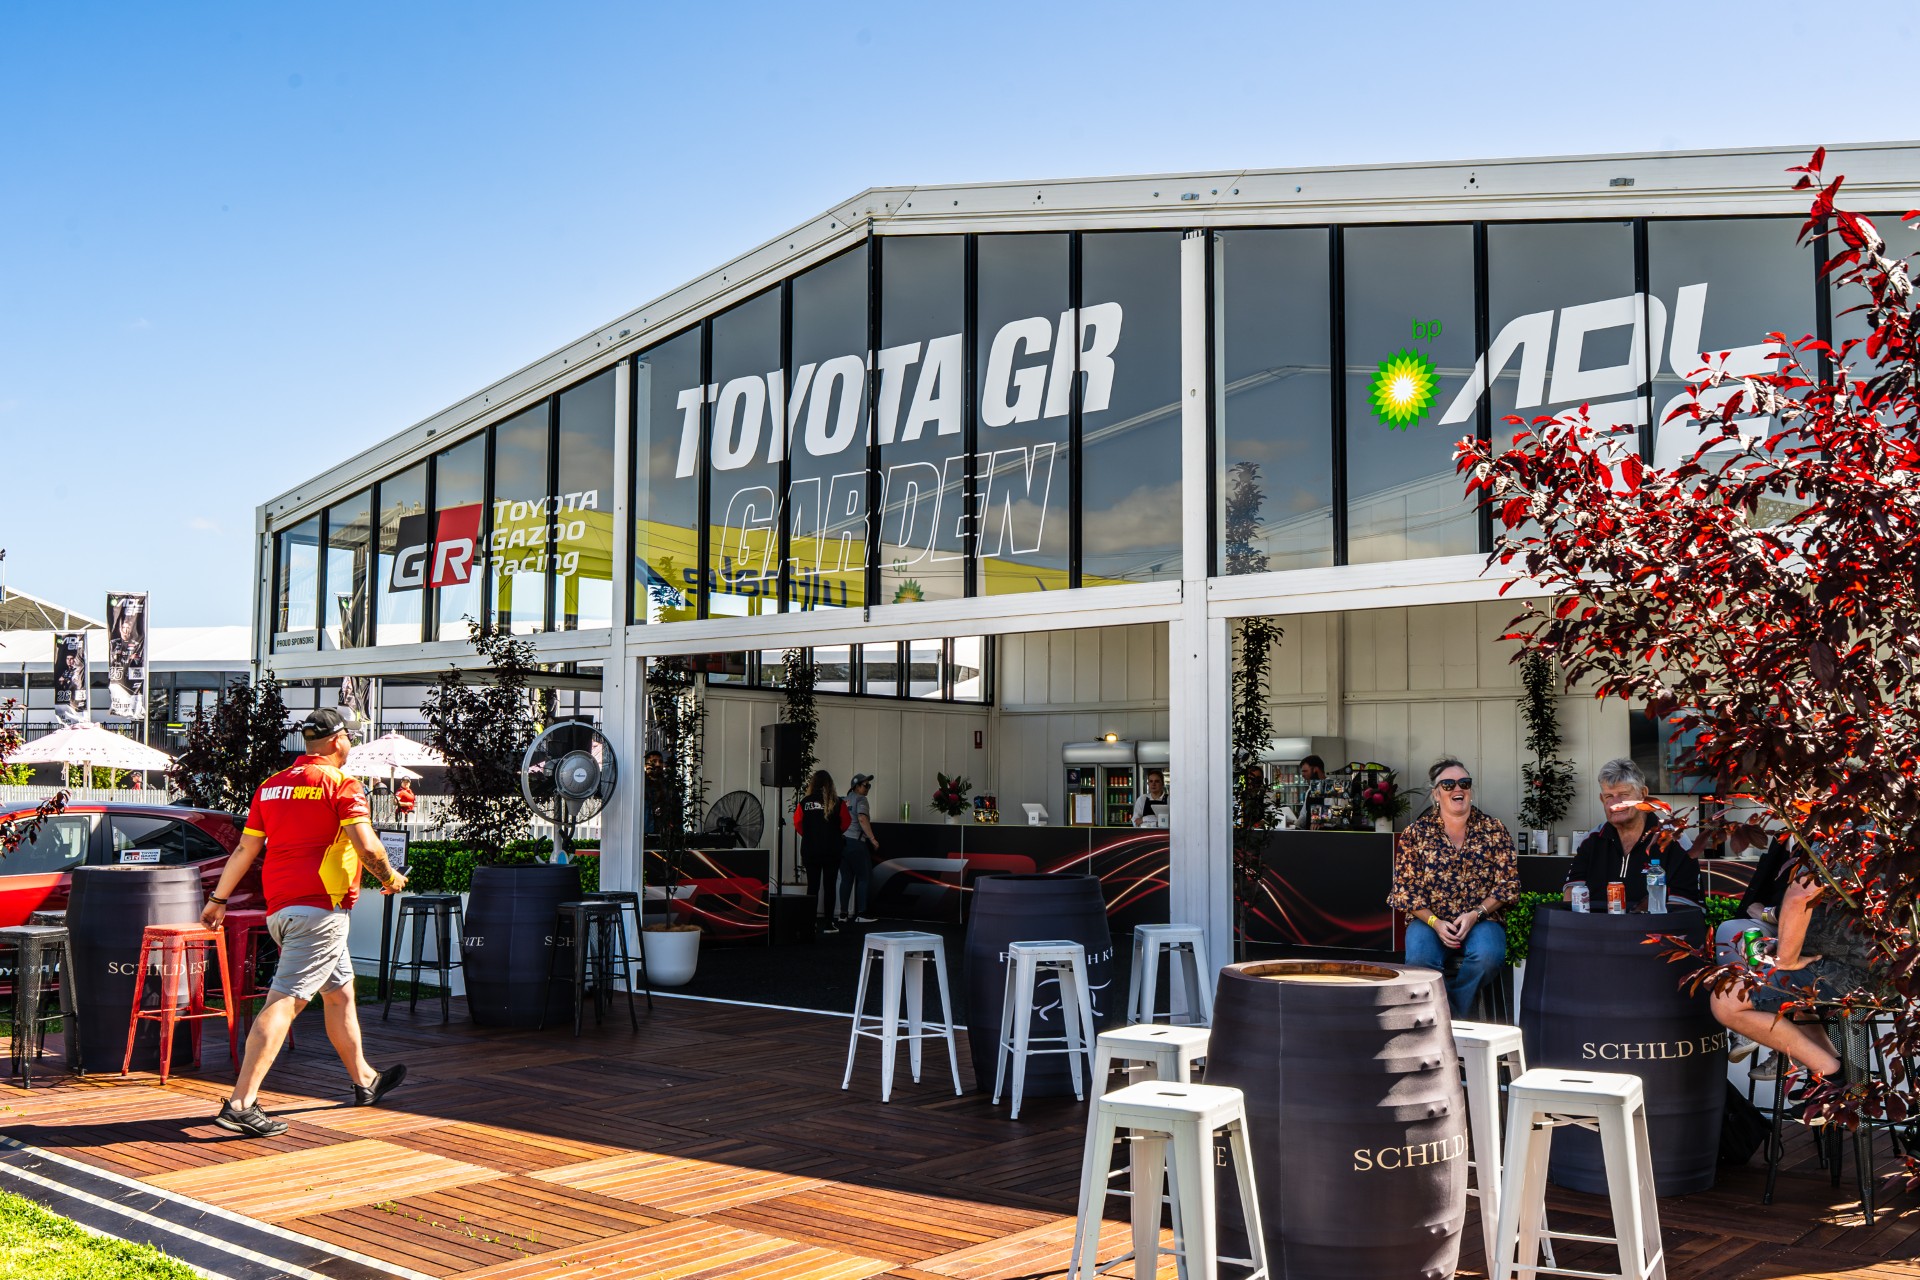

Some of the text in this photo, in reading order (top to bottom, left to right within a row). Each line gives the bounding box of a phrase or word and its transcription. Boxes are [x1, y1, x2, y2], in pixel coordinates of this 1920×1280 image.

[1411, 316, 1442, 343] bp
[1437, 283, 1782, 425] ADL
[675, 301, 1123, 478] TOYOTA GR
[493, 489, 598, 523] TOYOTA
[719, 442, 1056, 583] GARDEN
[489, 521, 585, 551] GAZOO
[393, 537, 473, 588] GR
[489, 549, 580, 577] Racing
[276, 636, 314, 647] PROUD SPONSORS
[260, 786, 323, 802] MAKE IT SUPER
[1582, 1040, 1694, 1060] SCHILD
[1354, 1134, 1464, 1171] SCHILD
